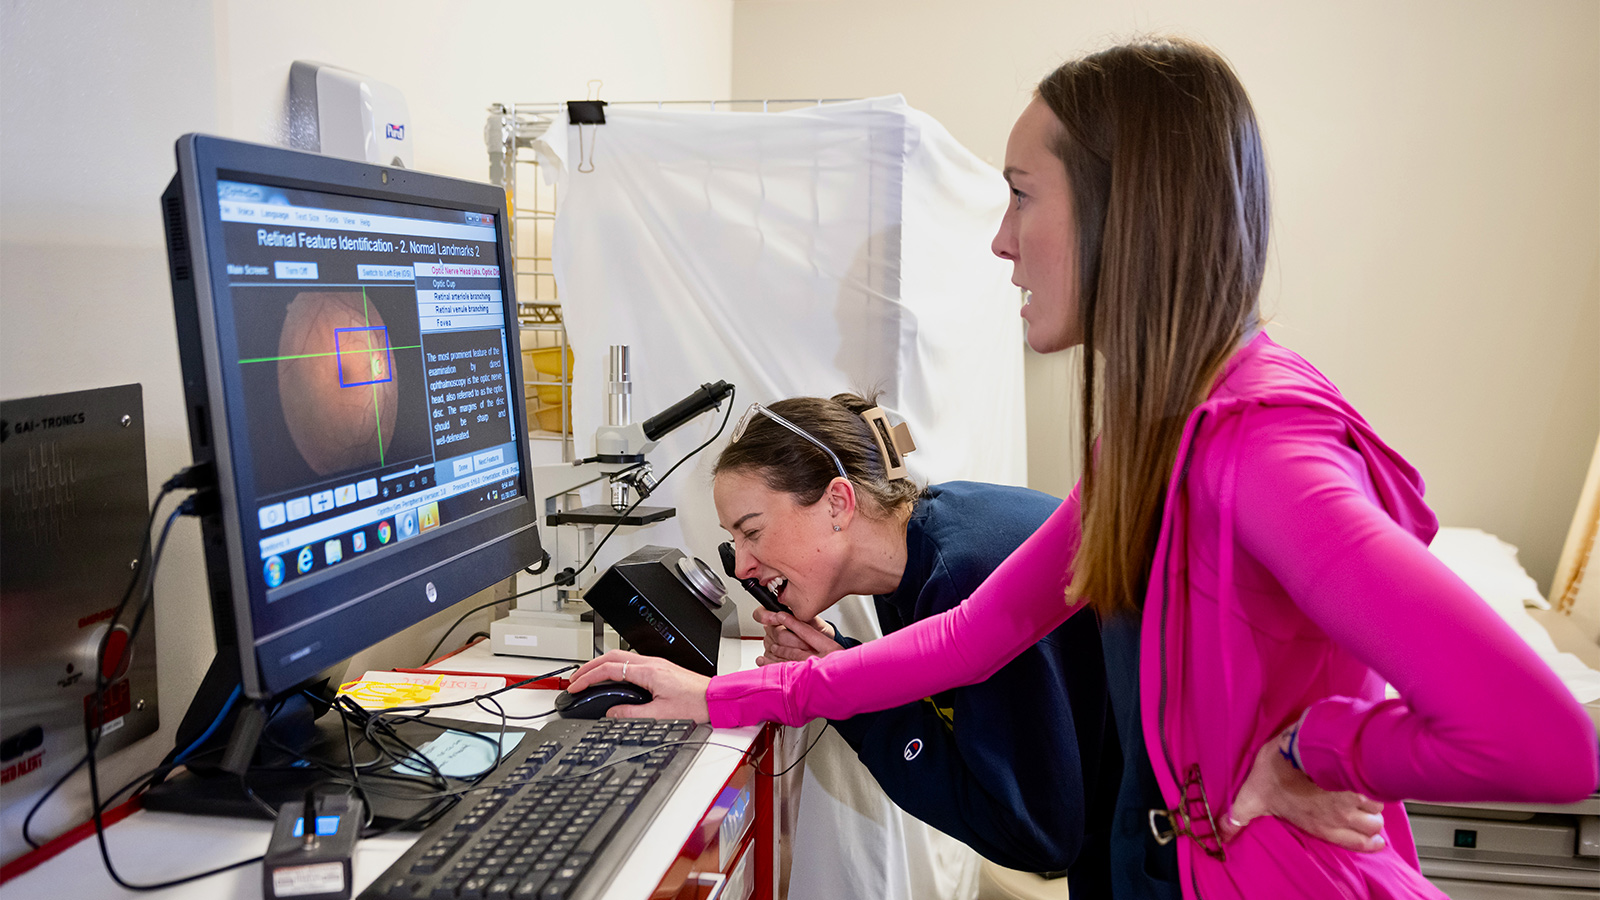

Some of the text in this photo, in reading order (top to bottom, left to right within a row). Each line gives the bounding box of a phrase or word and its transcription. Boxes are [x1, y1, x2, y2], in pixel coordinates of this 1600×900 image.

[257, 228, 297, 248] Retinal
[298, 232, 337, 250] Feature
[338, 235, 394, 252] Identification
[400, 240, 408, 253] 2.
[409, 241, 436, 255] Normal
[437, 243, 475, 257] Landmarks
[475, 245, 480, 257] 2
[432, 266, 444, 275] Optic
[445, 267, 458, 275] Nerve
[460, 267, 471, 275] Head
[481, 268, 492, 276] Optic
[433, 279, 456, 289] Optic Cup
[434, 292, 491, 301] Retinal arteriole branching
[436, 304, 489, 314] Retinal venule branching
[437, 319, 451, 327] Fovea
[426, 353, 436, 362] The
[438, 352, 449, 361] most
[450, 350, 472, 361] prominent
[472, 348, 487, 357] feature
[488, 347, 492, 355] of
[428, 360, 501, 377] examination by direct
[430, 378, 466, 392] ophthalmoscopy
[467, 377, 471, 385] is
[480, 374, 490, 384] optic
[446, 392, 456, 402] also
[457, 389, 474, 400] referred
[475, 389, 479, 397] to
[480, 388, 486, 396] as
[494, 385, 503, 394] optic
[447, 406, 456, 415] The
[460, 402, 477, 414] margins
[480, 400, 484, 409] of
[496, 397, 504, 405] disc
[15, 412, 85, 434] GAI-TRONICS
[434, 408, 506, 432] should be sharp and
[18, 753, 42, 777] ALERT
